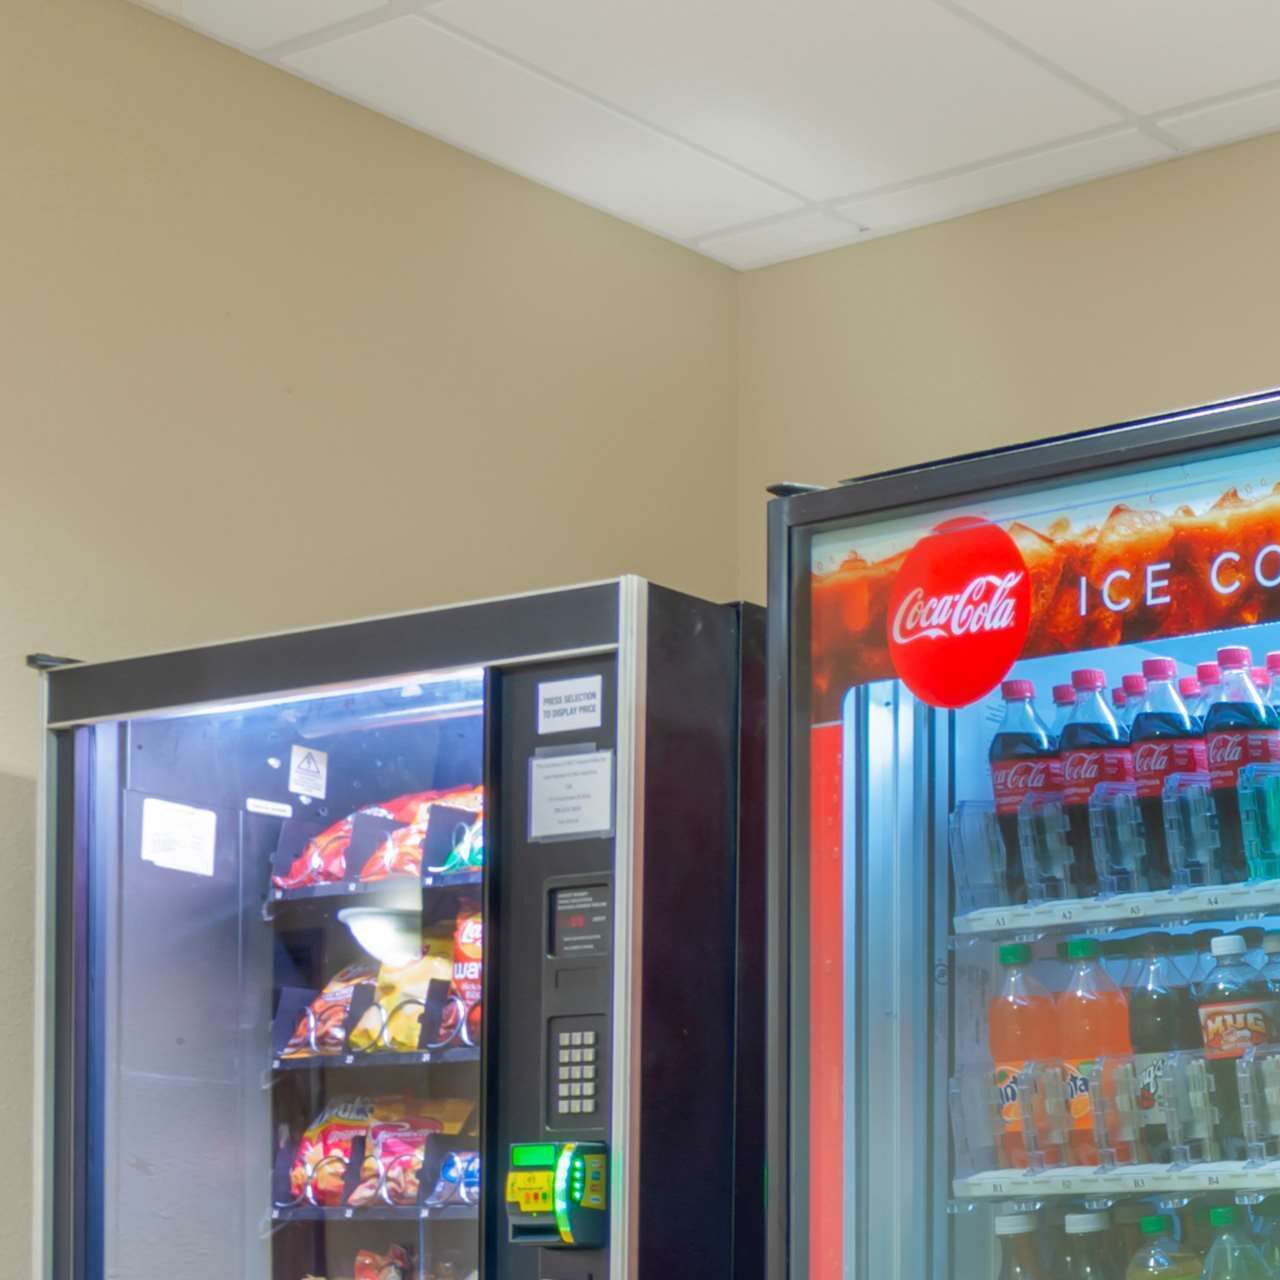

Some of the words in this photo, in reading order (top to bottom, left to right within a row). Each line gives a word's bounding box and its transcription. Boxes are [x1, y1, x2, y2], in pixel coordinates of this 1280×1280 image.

[1077, 561, 1173, 617] ICE
[892, 569, 1024, 645] Coca-Cola
[543, 695, 562, 705] PRESS
[564, 691, 597, 704] SELECTION
[543, 709, 551, 719] TO
[552, 706, 577, 718] DISPLAY
[579, 703, 596, 714] PRICE
[1207, 735, 1241, 764] Cola
[1135, 743, 1169, 773] Cola
[1063, 753, 1099, 781] Cola
[1207, 896, 1219, 906] A4
[1061, 910, 1073, 921] A2
[1130, 905, 1141, 915] A3
[994, 917, 1006, 927] A1
[1206, 1012, 1267, 1041] MUG
[1062, 1179, 1073, 1190] B2
[1133, 1179, 1145, 1189] B3
[1208, 1176, 1220, 1187] B4
[992, 1184, 1003, 1193] B1
